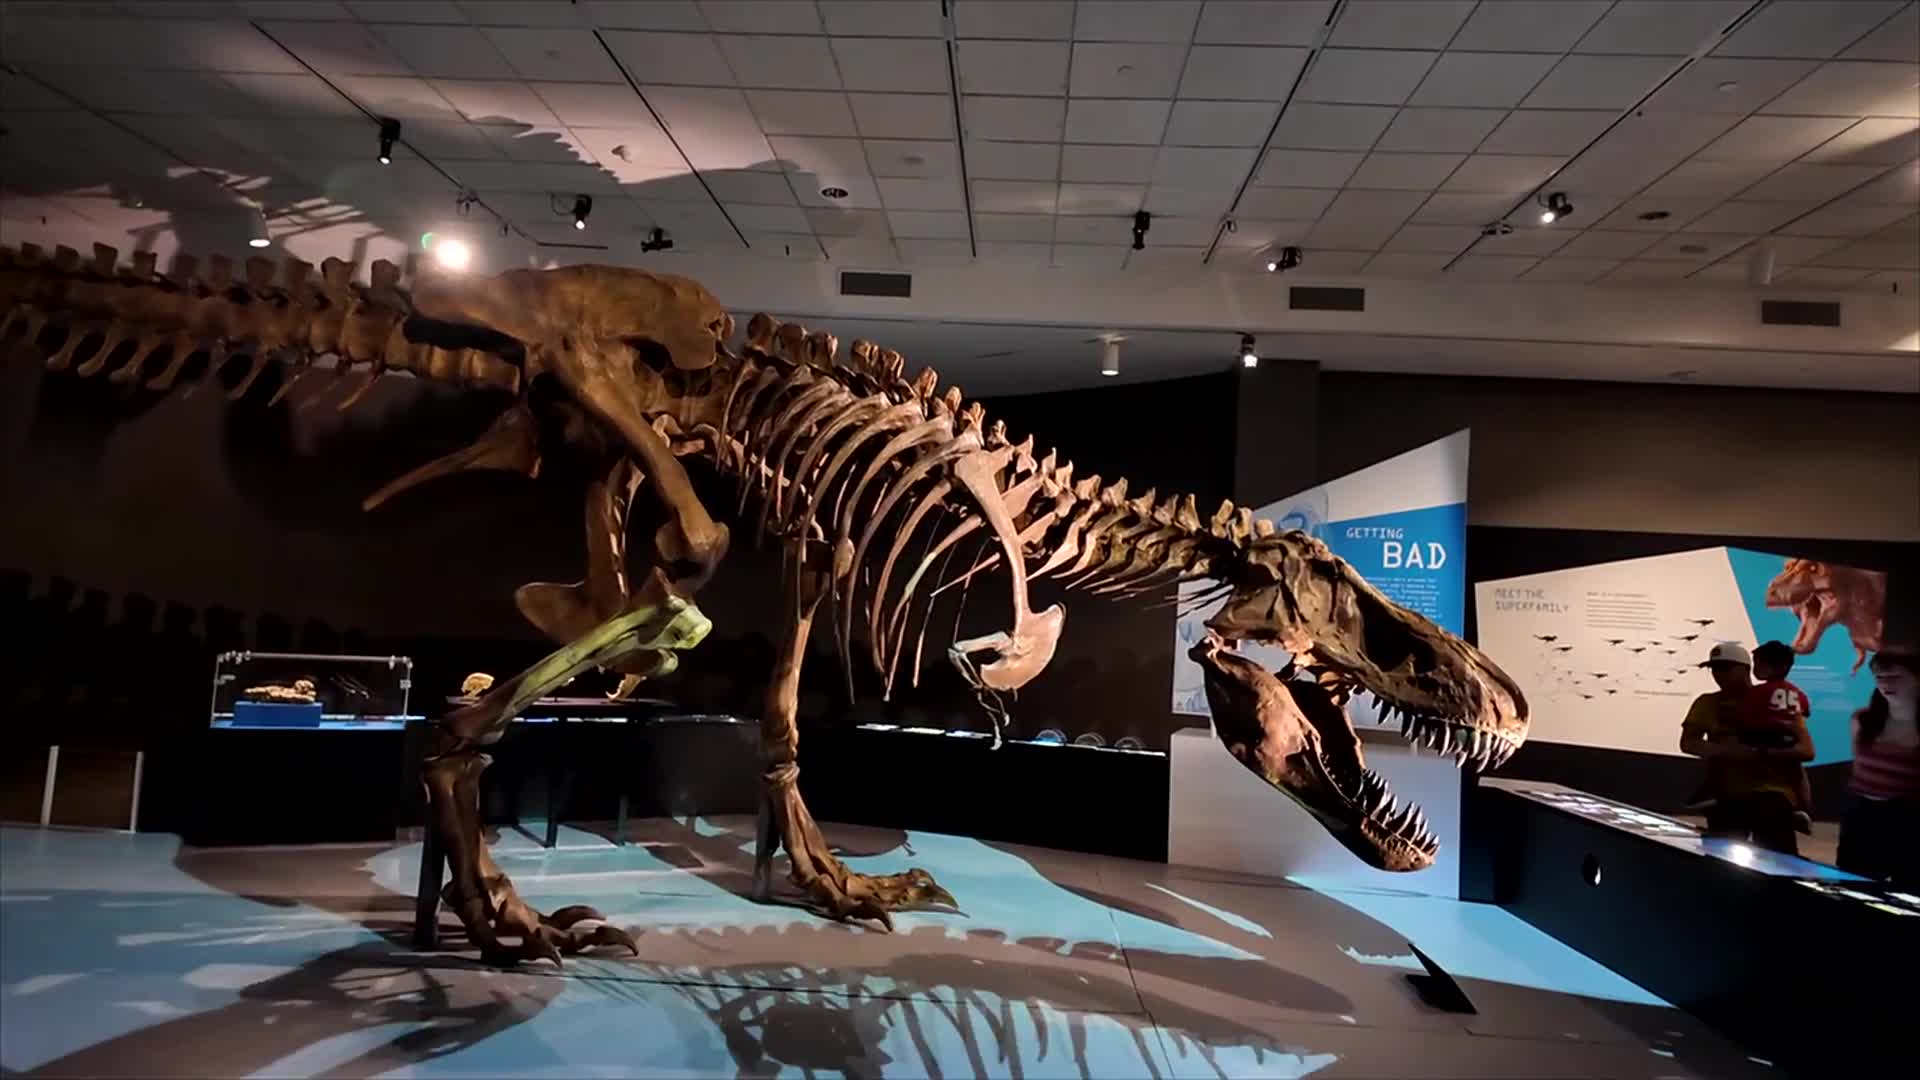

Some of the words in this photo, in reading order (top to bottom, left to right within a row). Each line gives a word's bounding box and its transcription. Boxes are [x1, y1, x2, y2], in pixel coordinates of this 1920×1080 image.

[1346, 527, 1404, 539] GETTING
[1383, 541, 1447, 569] BAD
[1495, 588, 1521, 599] MEET
[1525, 588, 1545, 600] THE
[1496, 600, 1569, 614] SUPERFAMILY
[1769, 688, 1801, 715] 95
